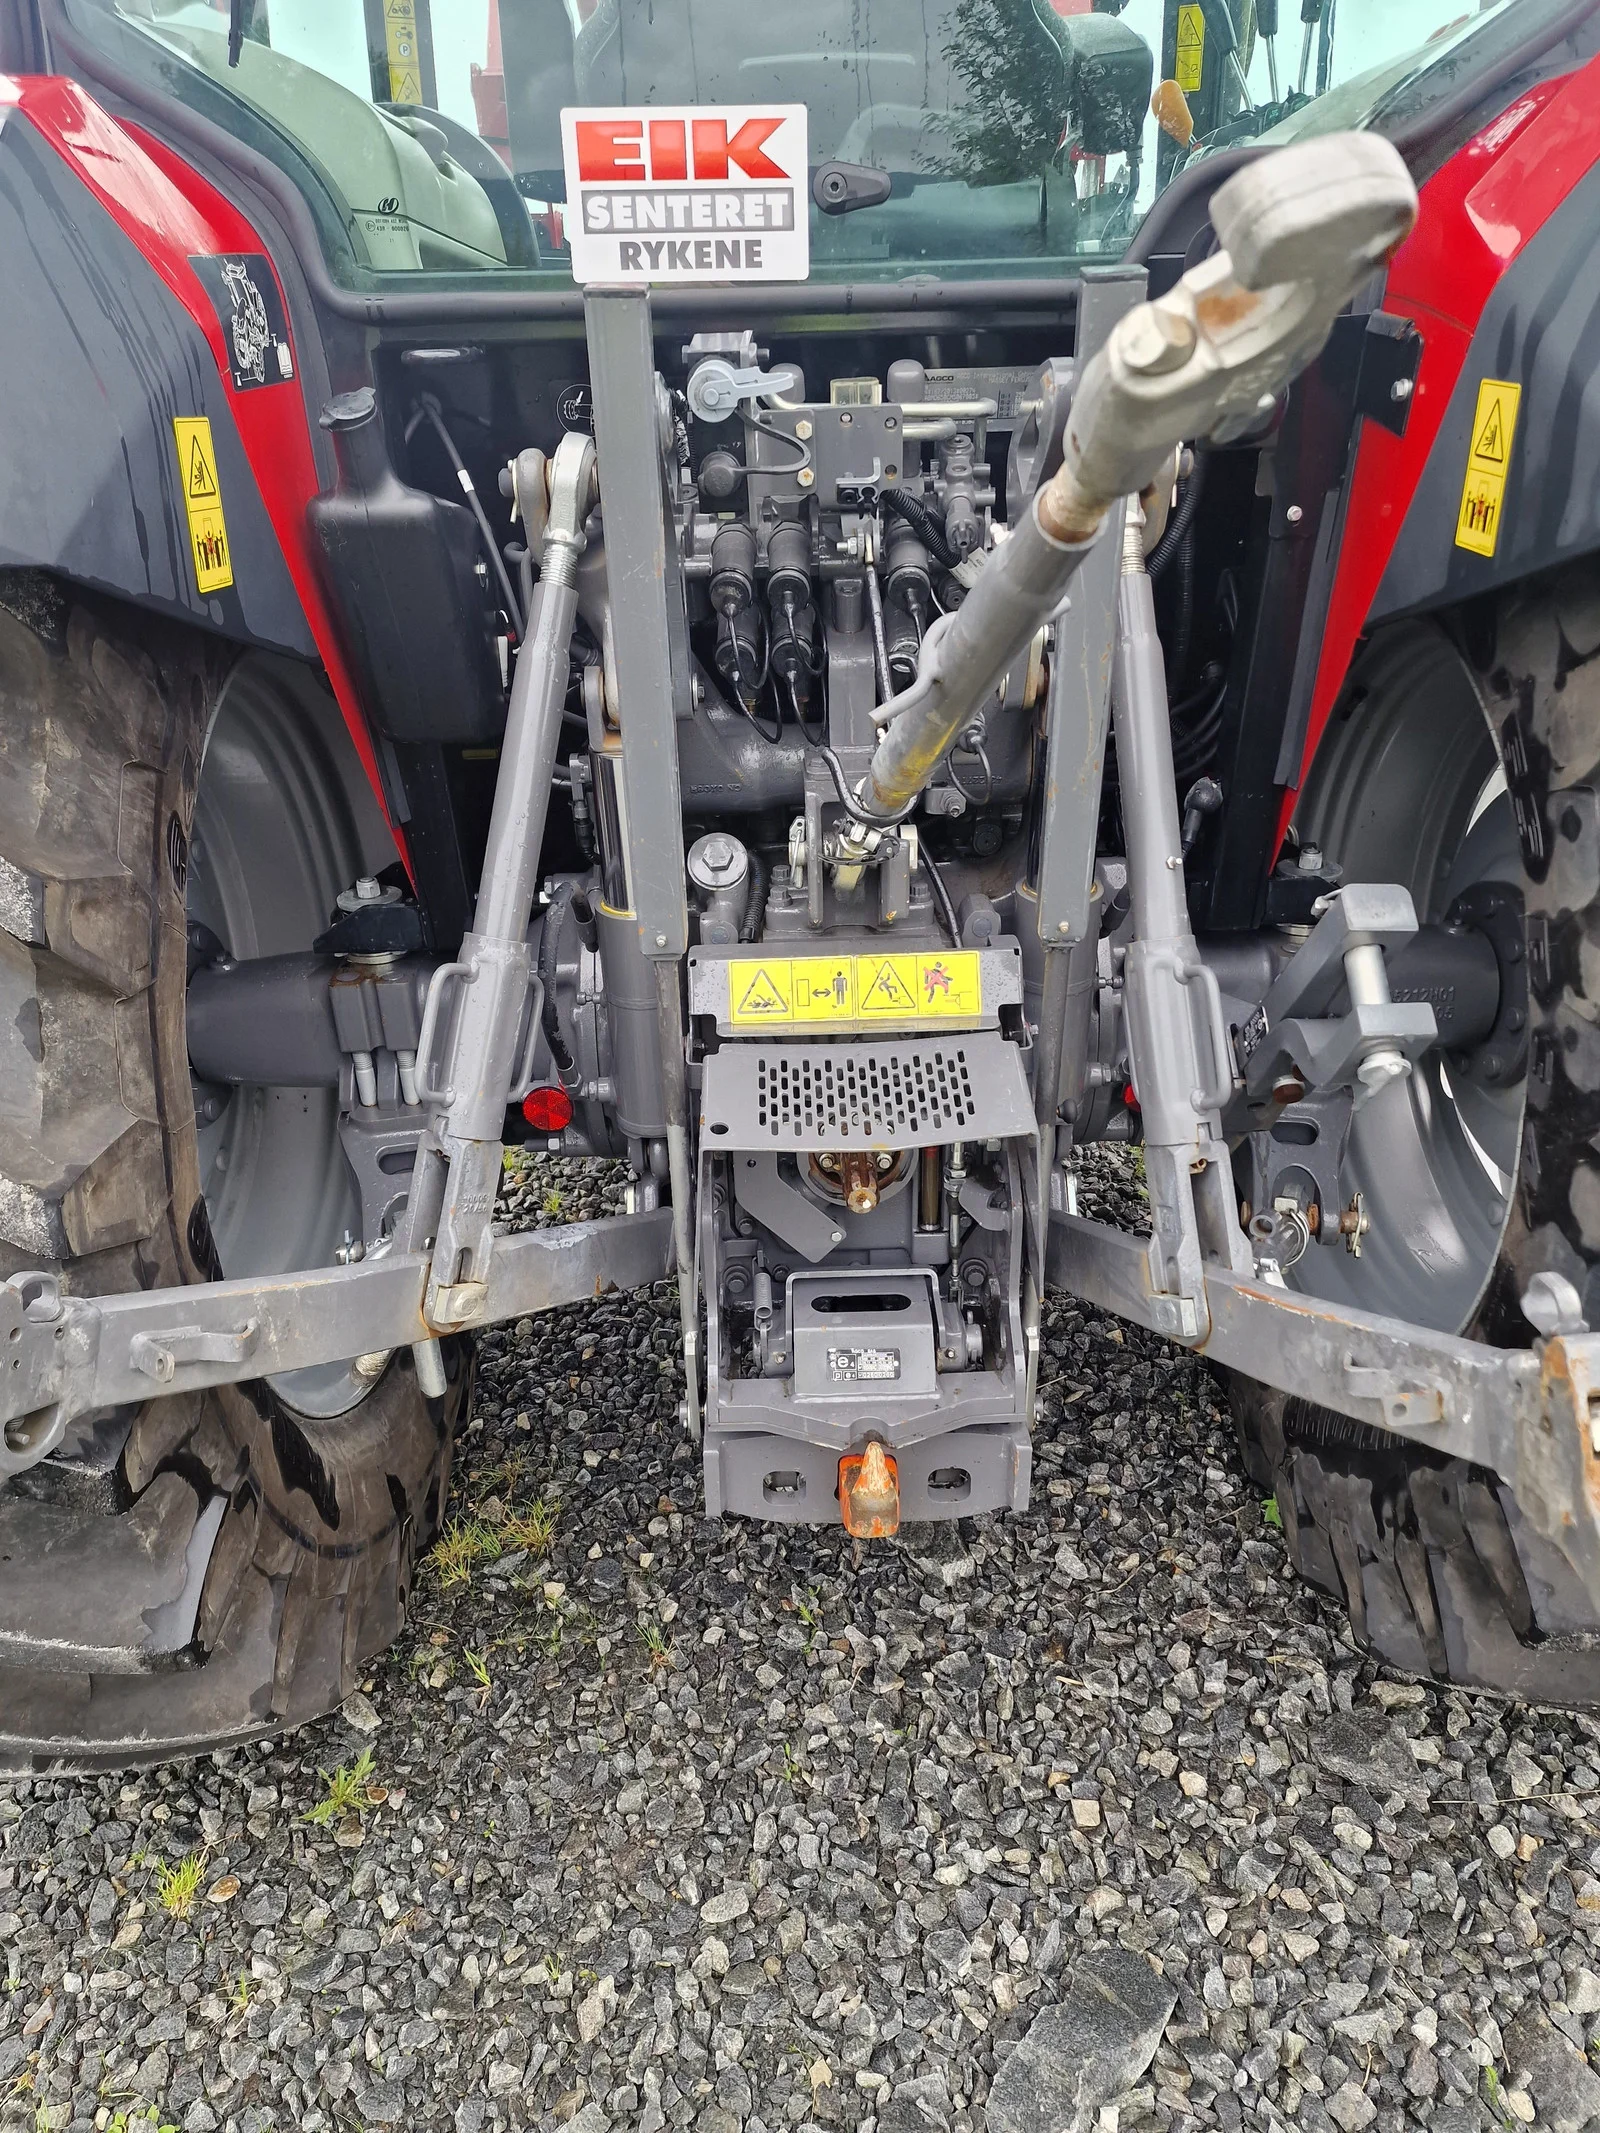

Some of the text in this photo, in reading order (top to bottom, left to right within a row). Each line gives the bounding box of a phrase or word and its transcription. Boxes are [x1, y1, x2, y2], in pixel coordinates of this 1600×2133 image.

[576, 118, 792, 181] EIK
[586, 193, 789, 229] SENTERET
[619, 239, 763, 271] RYKENE
